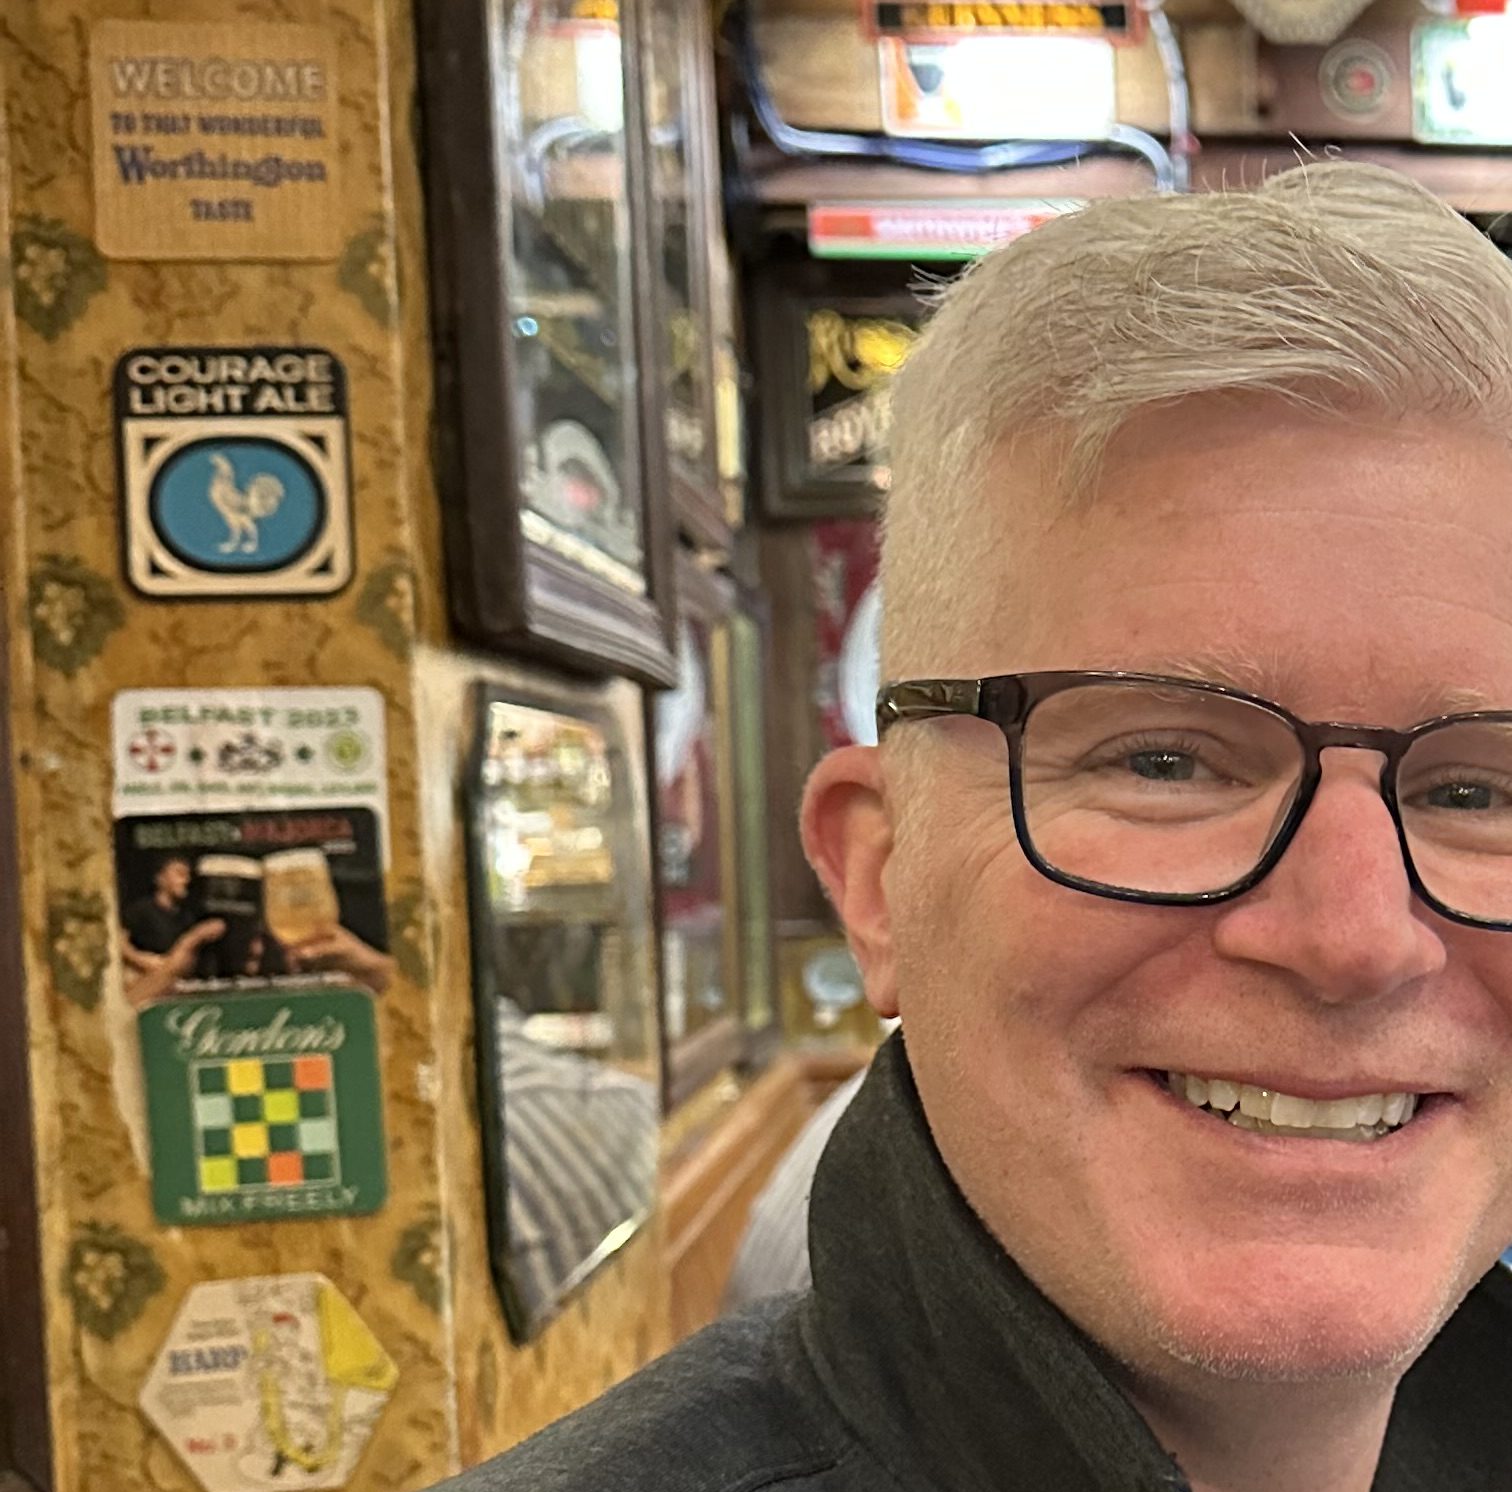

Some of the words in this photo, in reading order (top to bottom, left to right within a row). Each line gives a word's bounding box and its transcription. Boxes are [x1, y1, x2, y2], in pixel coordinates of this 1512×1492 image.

[110, 58, 327, 99] WELCOME
[110, 112, 136, 135] TO
[113, 145, 326, 187] Worthington
[127, 354, 335, 385] COURAGE
[129, 385, 248, 414] LIGHT
[254, 384, 335, 412] ALE
[139, 706, 276, 727] BELFAST
[166, 1006, 346, 1056] Gordon's
